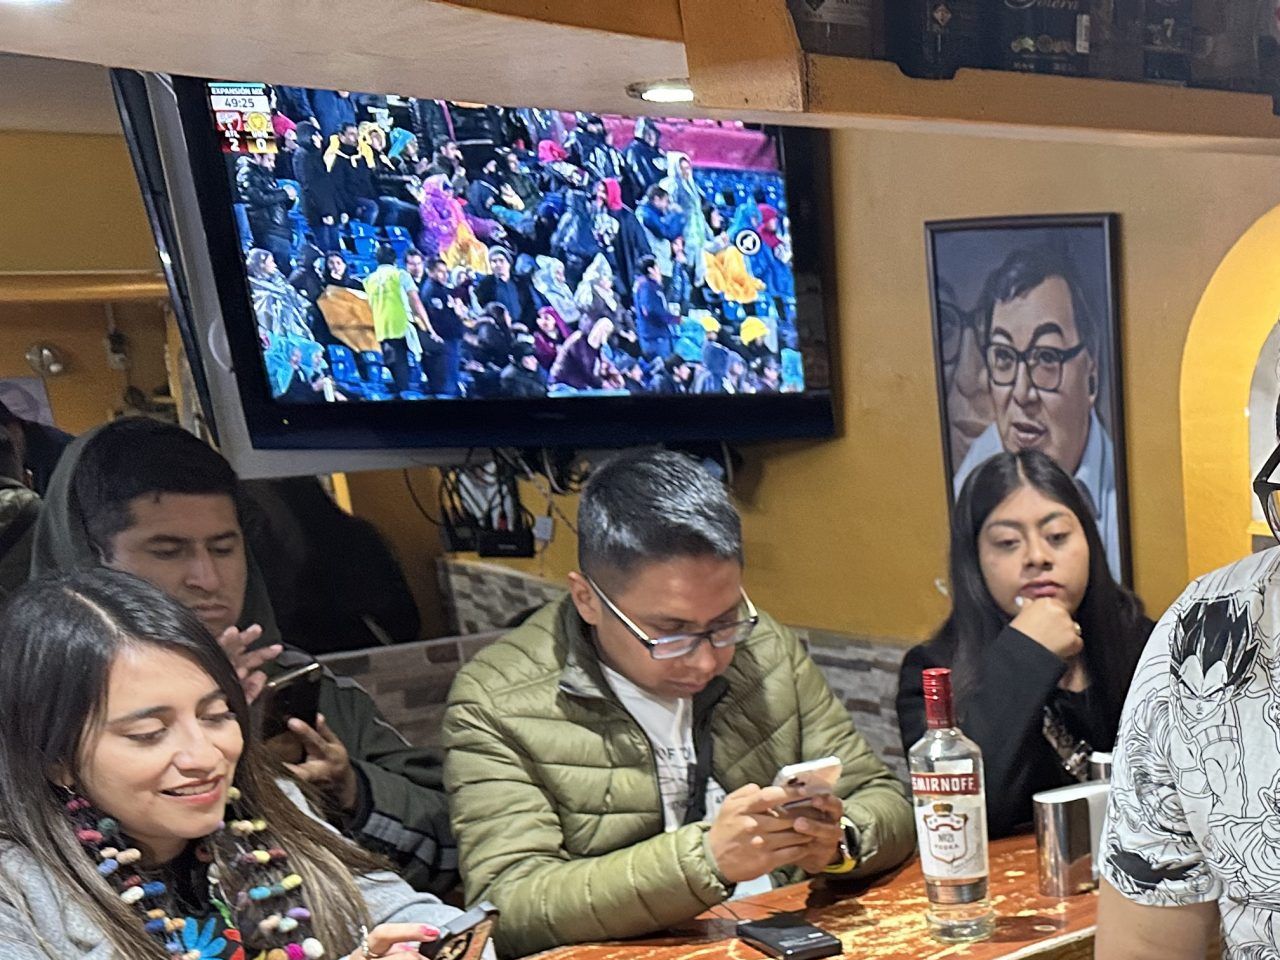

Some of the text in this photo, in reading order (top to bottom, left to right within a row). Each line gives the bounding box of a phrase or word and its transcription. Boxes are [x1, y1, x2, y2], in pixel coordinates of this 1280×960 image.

[224, 97, 255, 108] 49:25
[229, 138, 241, 152] 2
[255, 138, 267, 152] 0
[912, 776, 975, 792] SMIRNOFF
